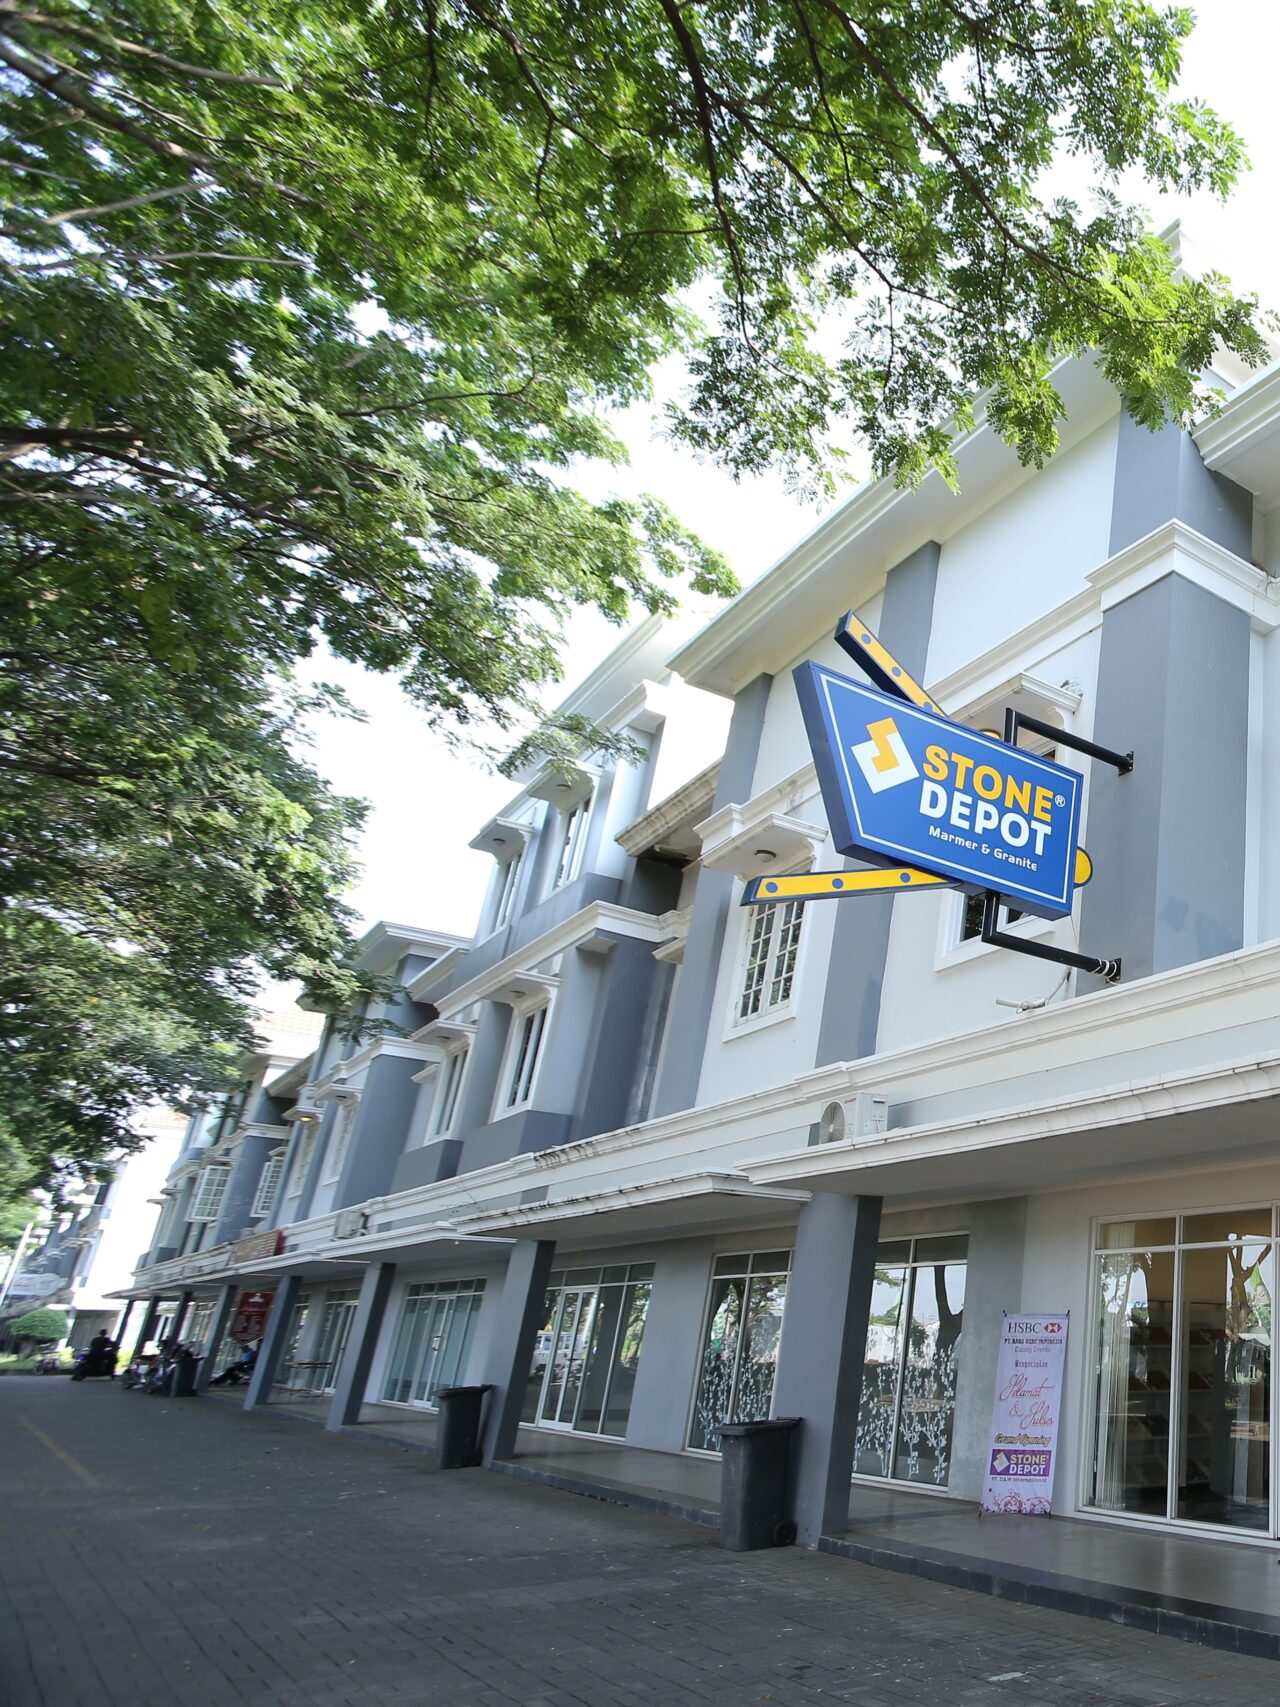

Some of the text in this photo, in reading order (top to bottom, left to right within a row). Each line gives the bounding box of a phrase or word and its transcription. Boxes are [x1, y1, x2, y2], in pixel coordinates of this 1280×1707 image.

[923, 745, 1053, 822] STONE
[919, 779, 1051, 856] DEPOT
[929, 825, 1038, 871] Marmer & Granite
[1008, 1322, 1041, 1333] HSBC
[1000, 1373, 1056, 1401] Selamat
[1020, 1401, 1053, 1429] Sukses
[995, 1433, 1051, 1447] Grand Opening
[1009, 1464, 1046, 1474] DEPOT
[1010, 1454, 1046, 1464] STONE
